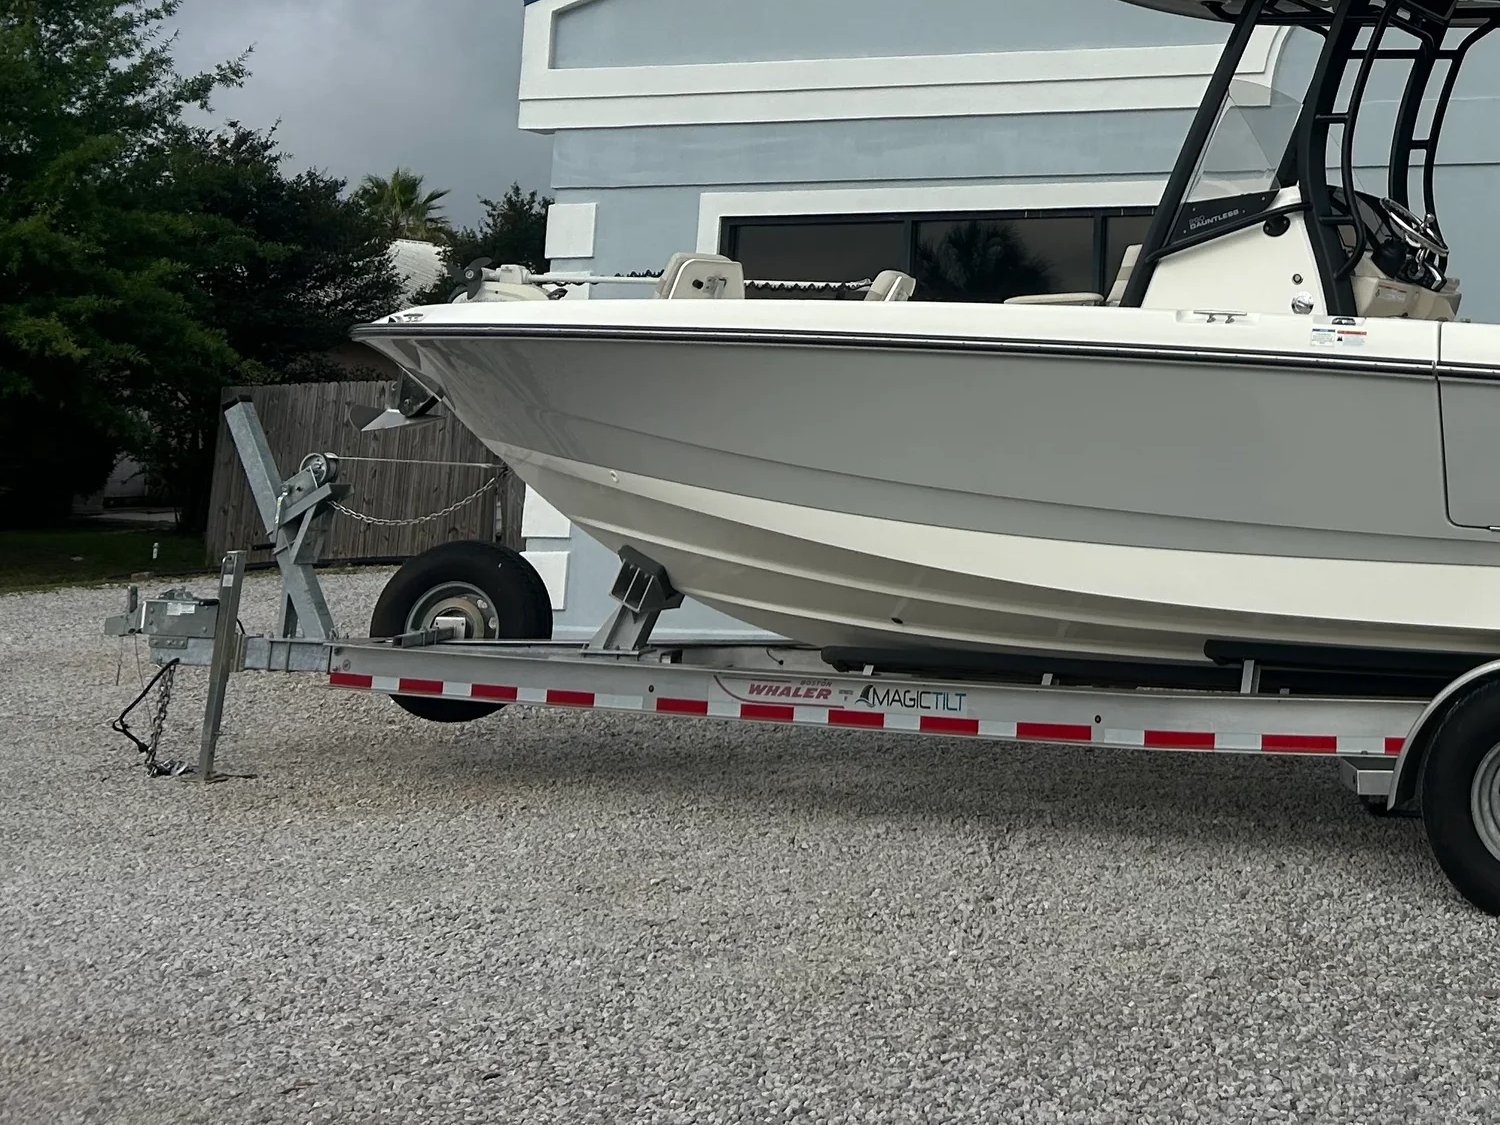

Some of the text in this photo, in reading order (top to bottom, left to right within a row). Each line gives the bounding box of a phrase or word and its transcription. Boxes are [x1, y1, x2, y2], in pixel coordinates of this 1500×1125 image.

[748, 683, 832, 700] WHALER
[800, 679, 832, 687] BOSTON
[872, 687, 966, 712] MAGICTILT
